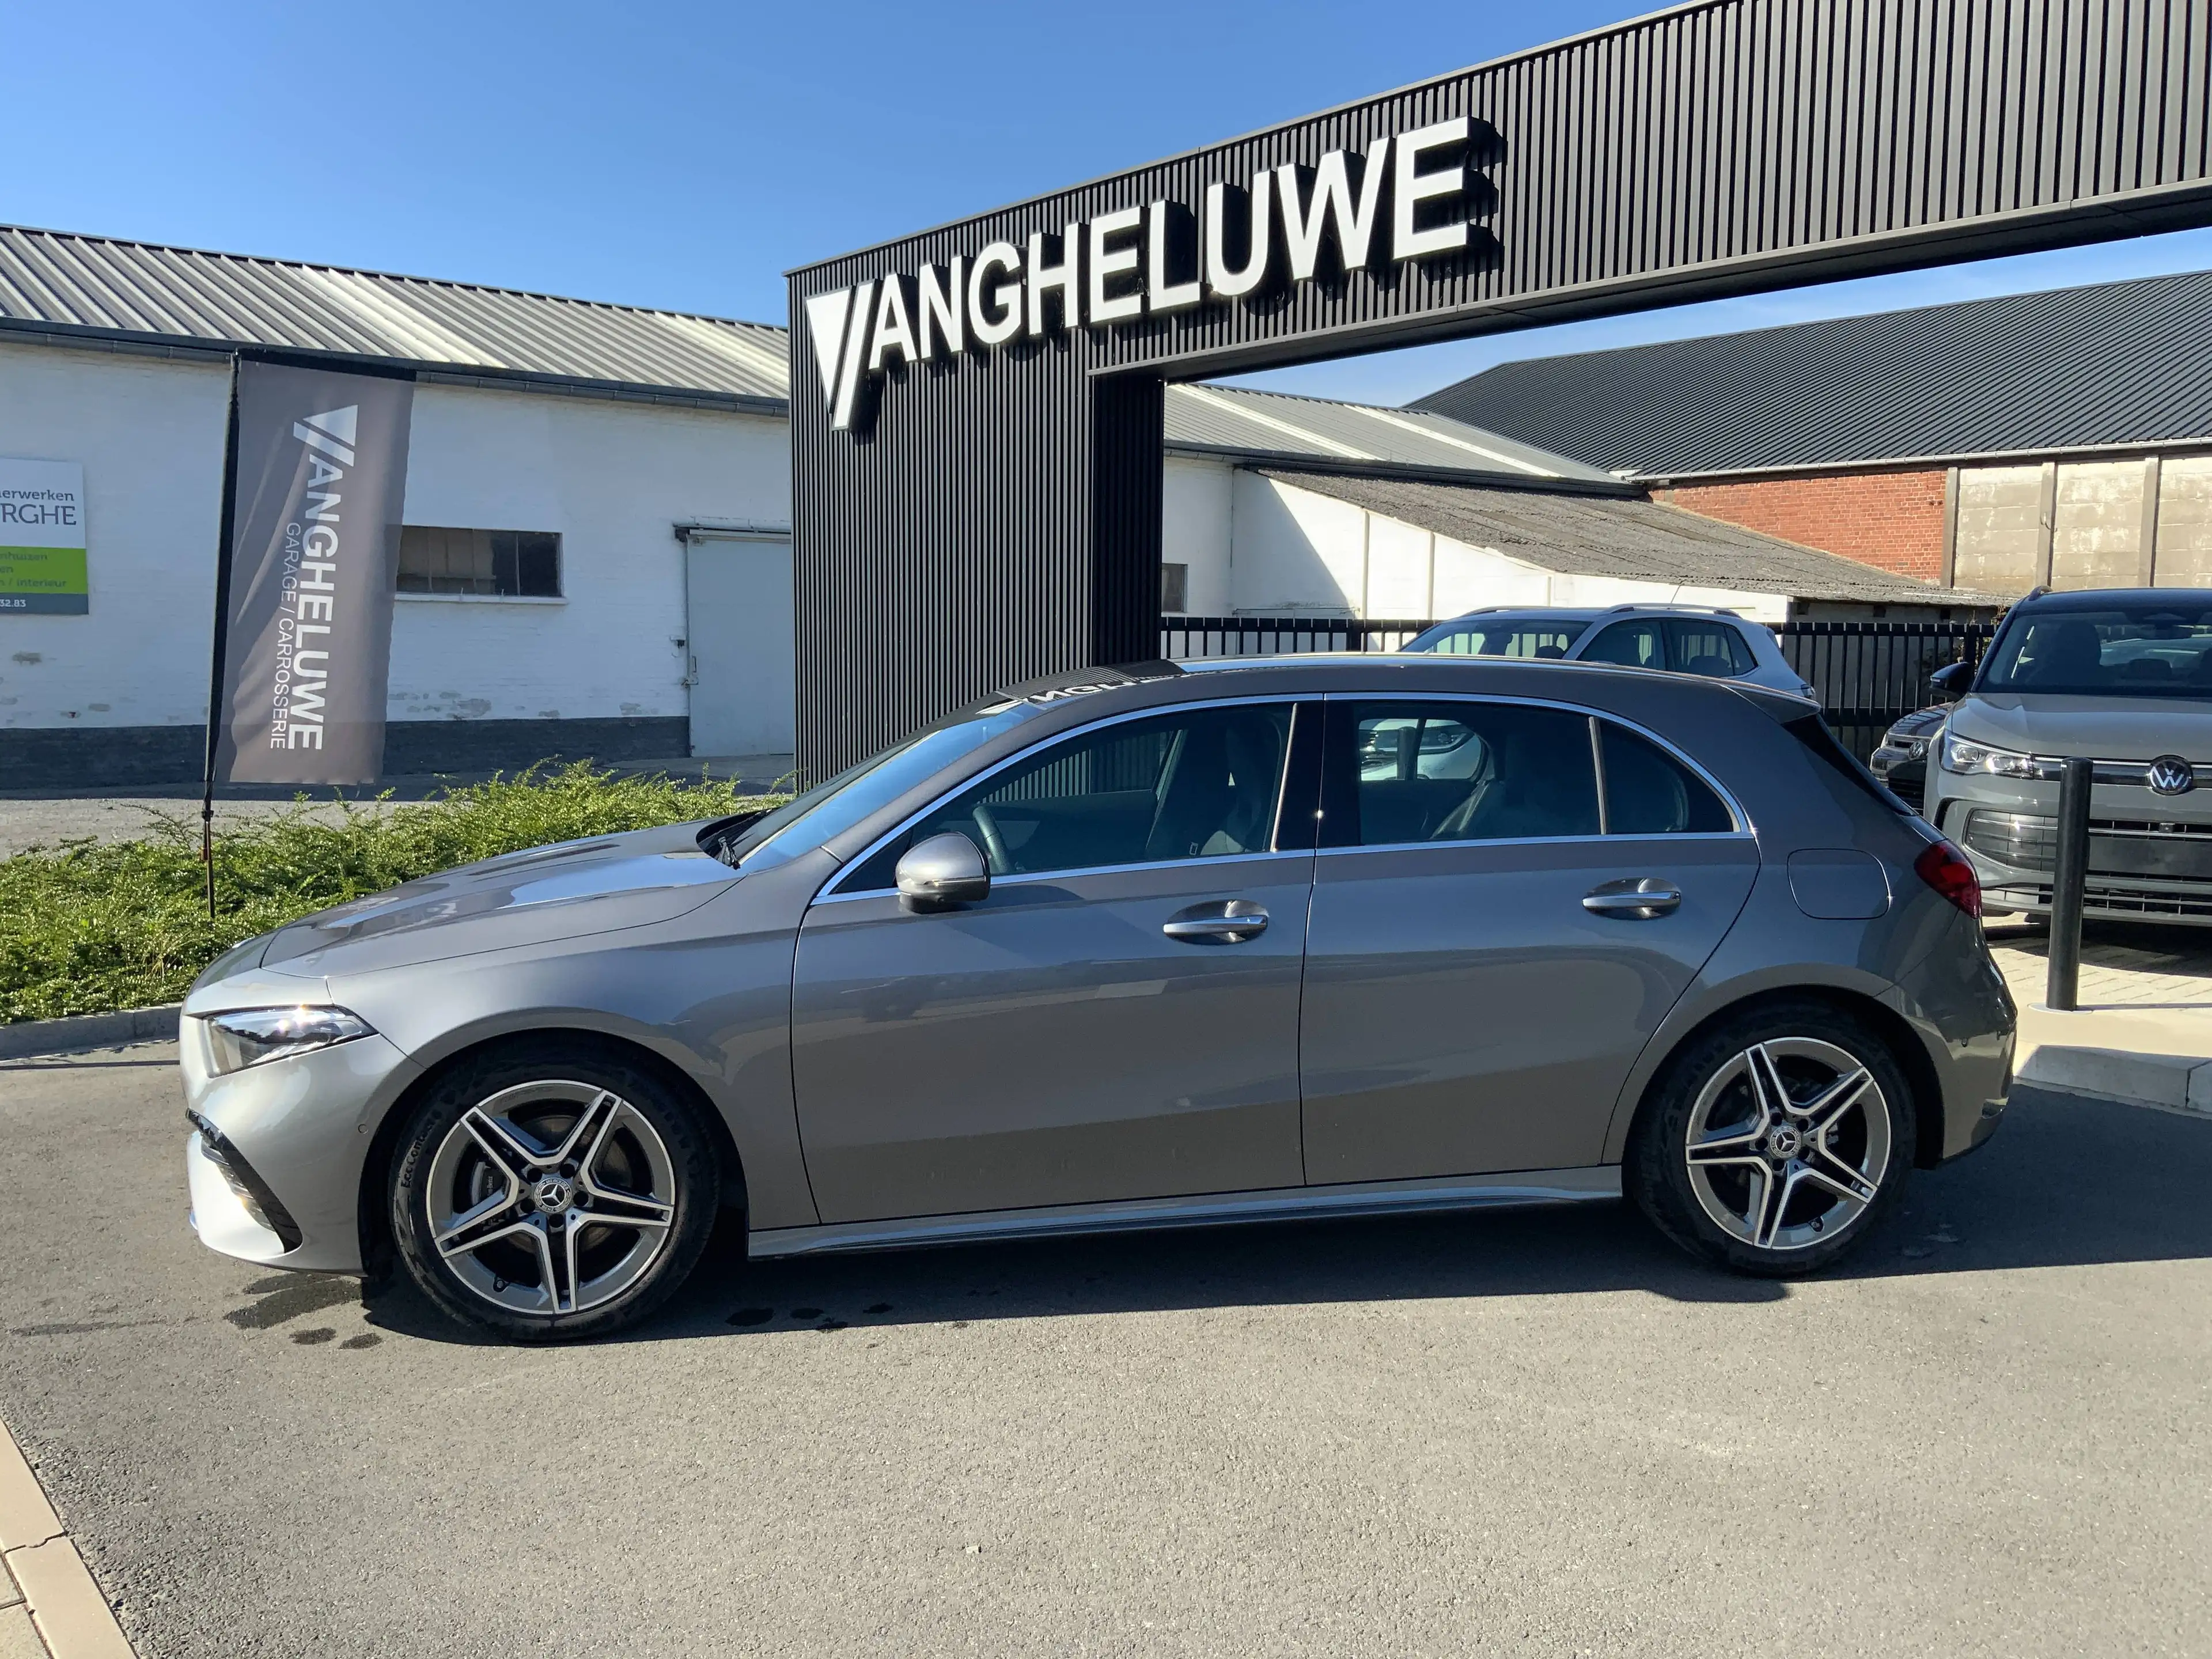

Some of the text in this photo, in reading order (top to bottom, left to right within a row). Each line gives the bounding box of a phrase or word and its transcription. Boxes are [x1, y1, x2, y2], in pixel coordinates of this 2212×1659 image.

[806, 116, 1470, 431] VANGHELUWE
[0, 490, 74, 501] erwerken
[281, 522, 301, 603] GARAGE
[288, 404, 358, 749] VANGHELUWE
[270, 618, 294, 749] CARROSSERIE
